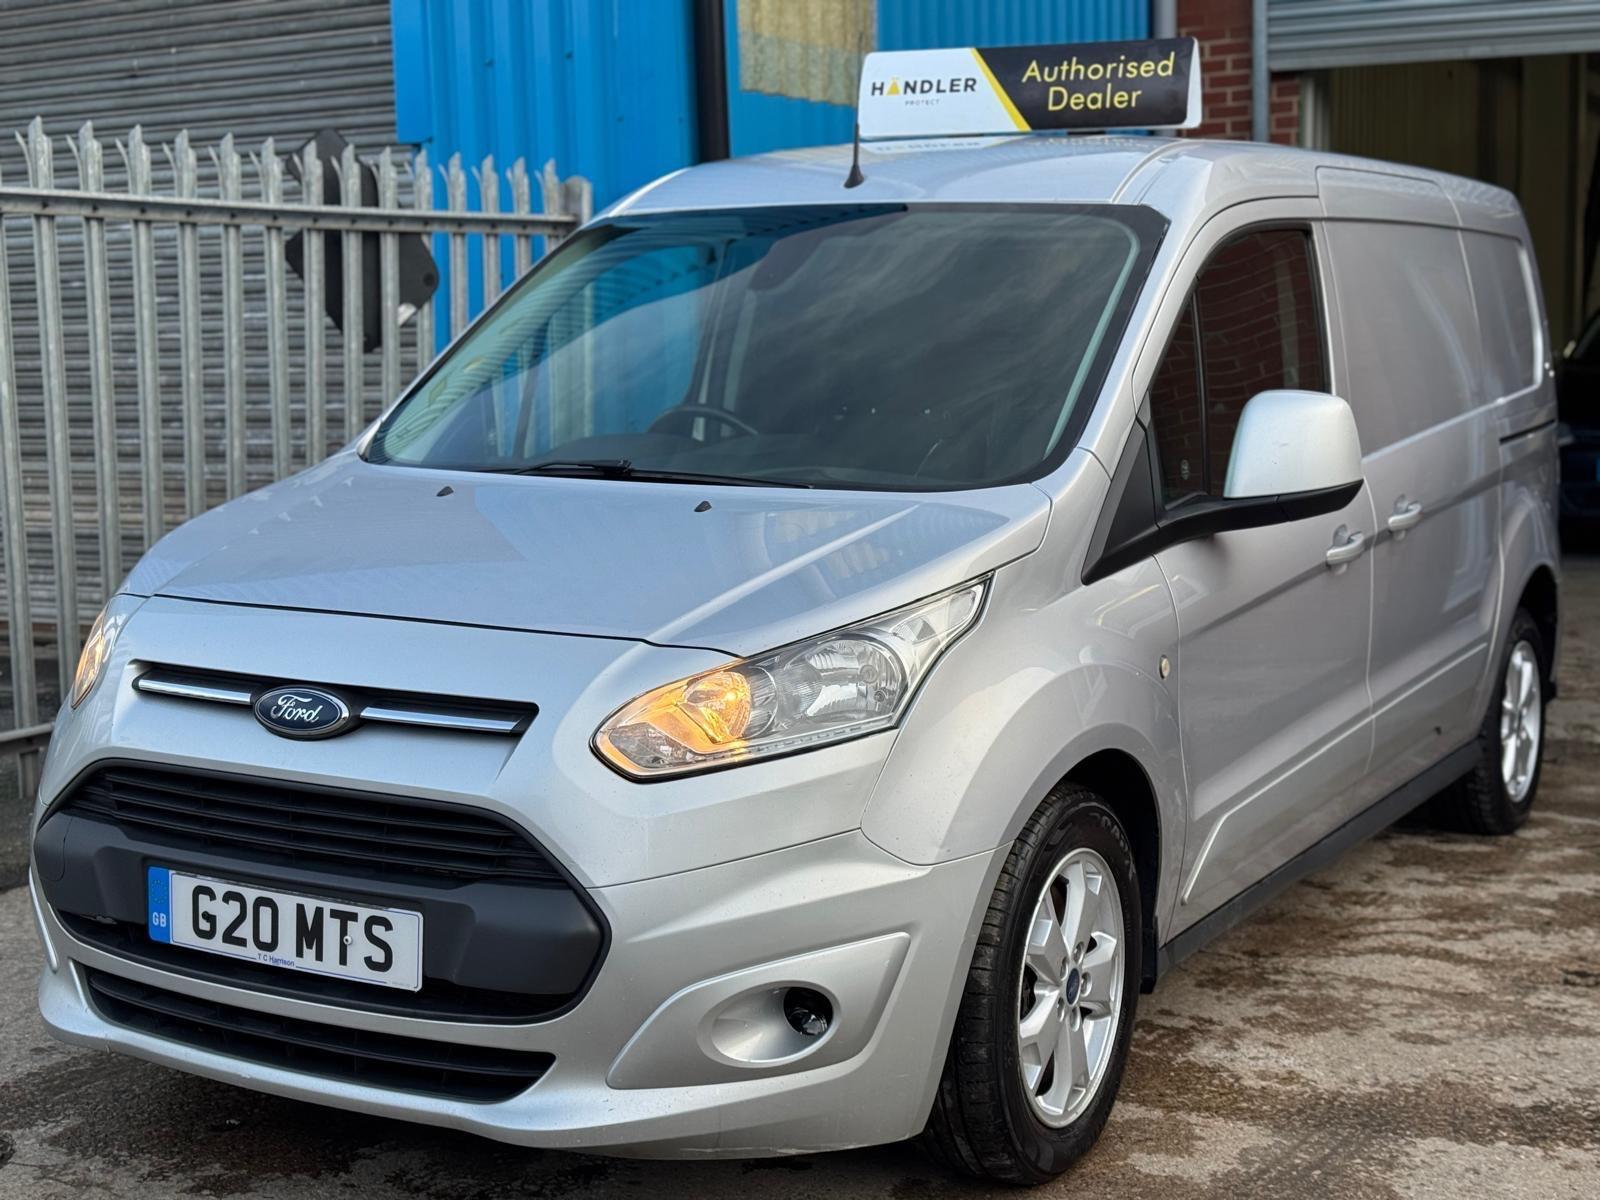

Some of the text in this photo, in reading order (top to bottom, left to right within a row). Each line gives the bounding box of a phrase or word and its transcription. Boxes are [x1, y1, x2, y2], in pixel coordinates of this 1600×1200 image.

[1021, 51, 1175, 83] Authorised
[1047, 82, 1142, 111] Dealer
[270, 694, 324, 723] Ford
[152, 911, 167, 928] GB
[191, 885, 394, 973] G20 MTS
[262, 954, 268, 962] C
